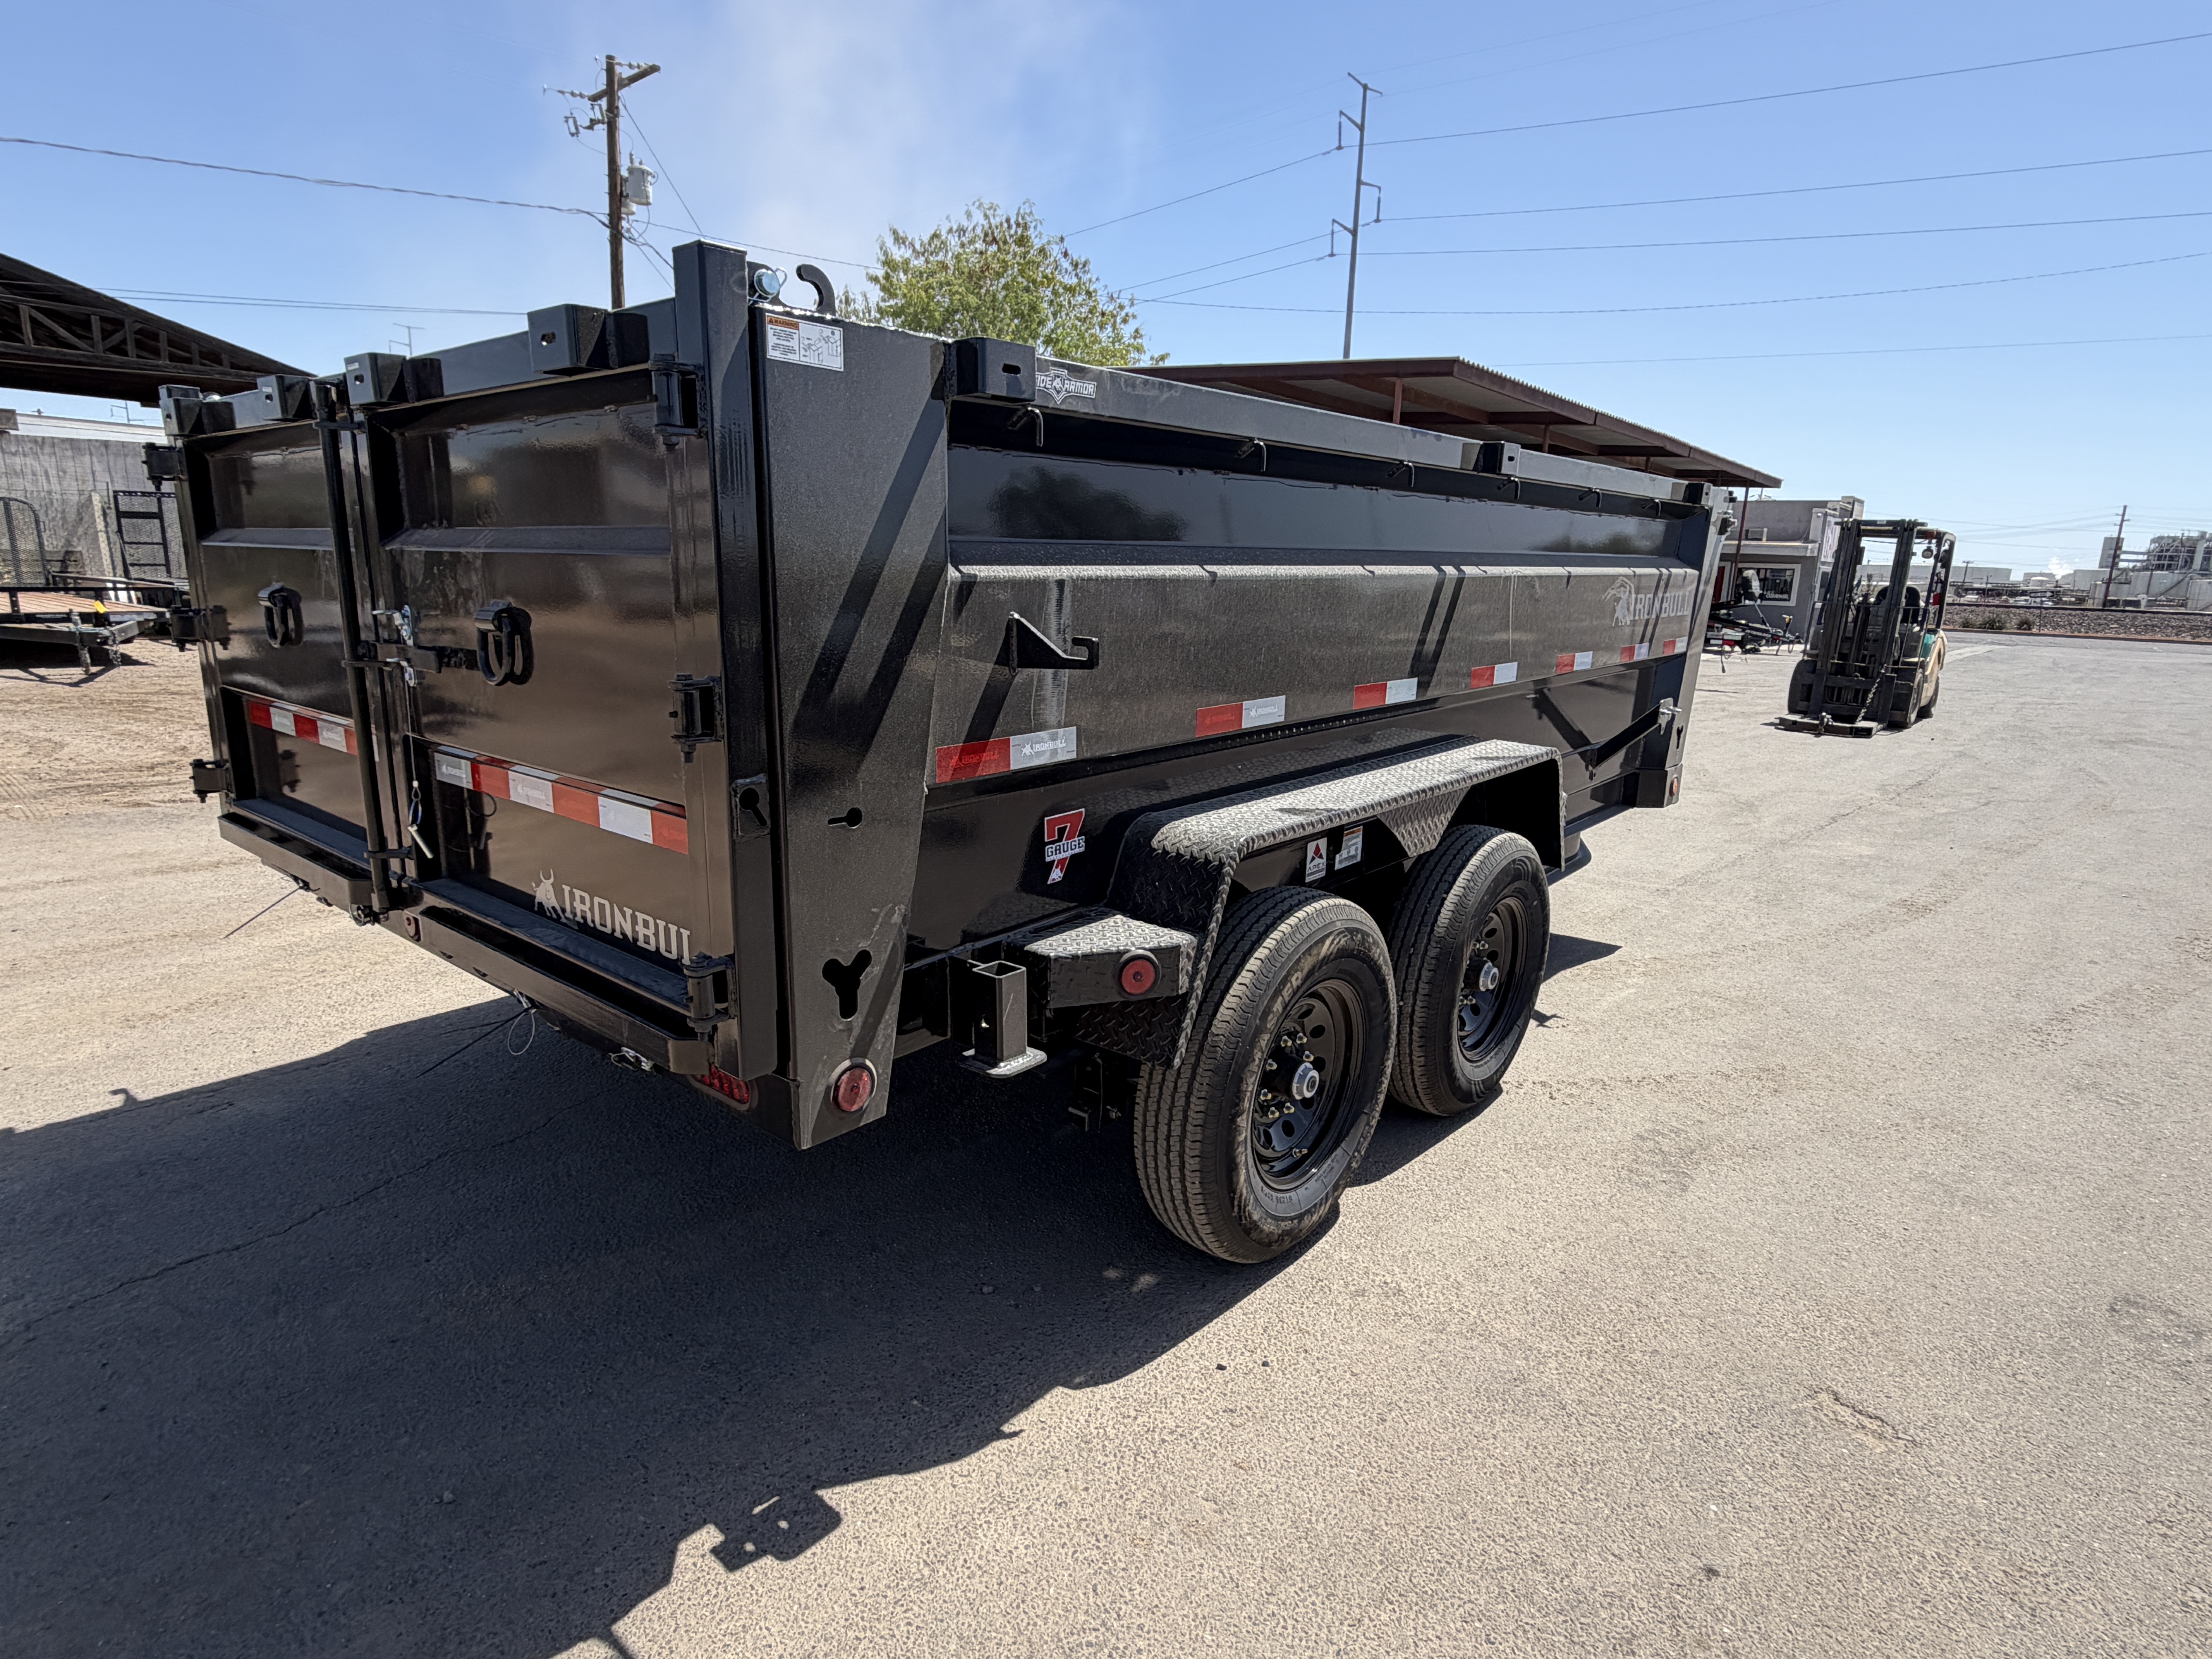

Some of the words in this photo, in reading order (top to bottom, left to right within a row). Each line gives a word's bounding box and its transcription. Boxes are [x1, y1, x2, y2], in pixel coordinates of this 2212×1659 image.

[774, 318, 798, 329] WARNING
[1036, 374, 1053, 388] IDE
[1065, 380, 1094, 395] ARMOR
[1629, 592, 1690, 621] IRONBULL
[1033, 736, 1066, 752] IRONBULL
[1045, 808, 1085, 884] 7
[1046, 837, 1085, 857] GAUGE
[1307, 862, 1326, 873] APEX
